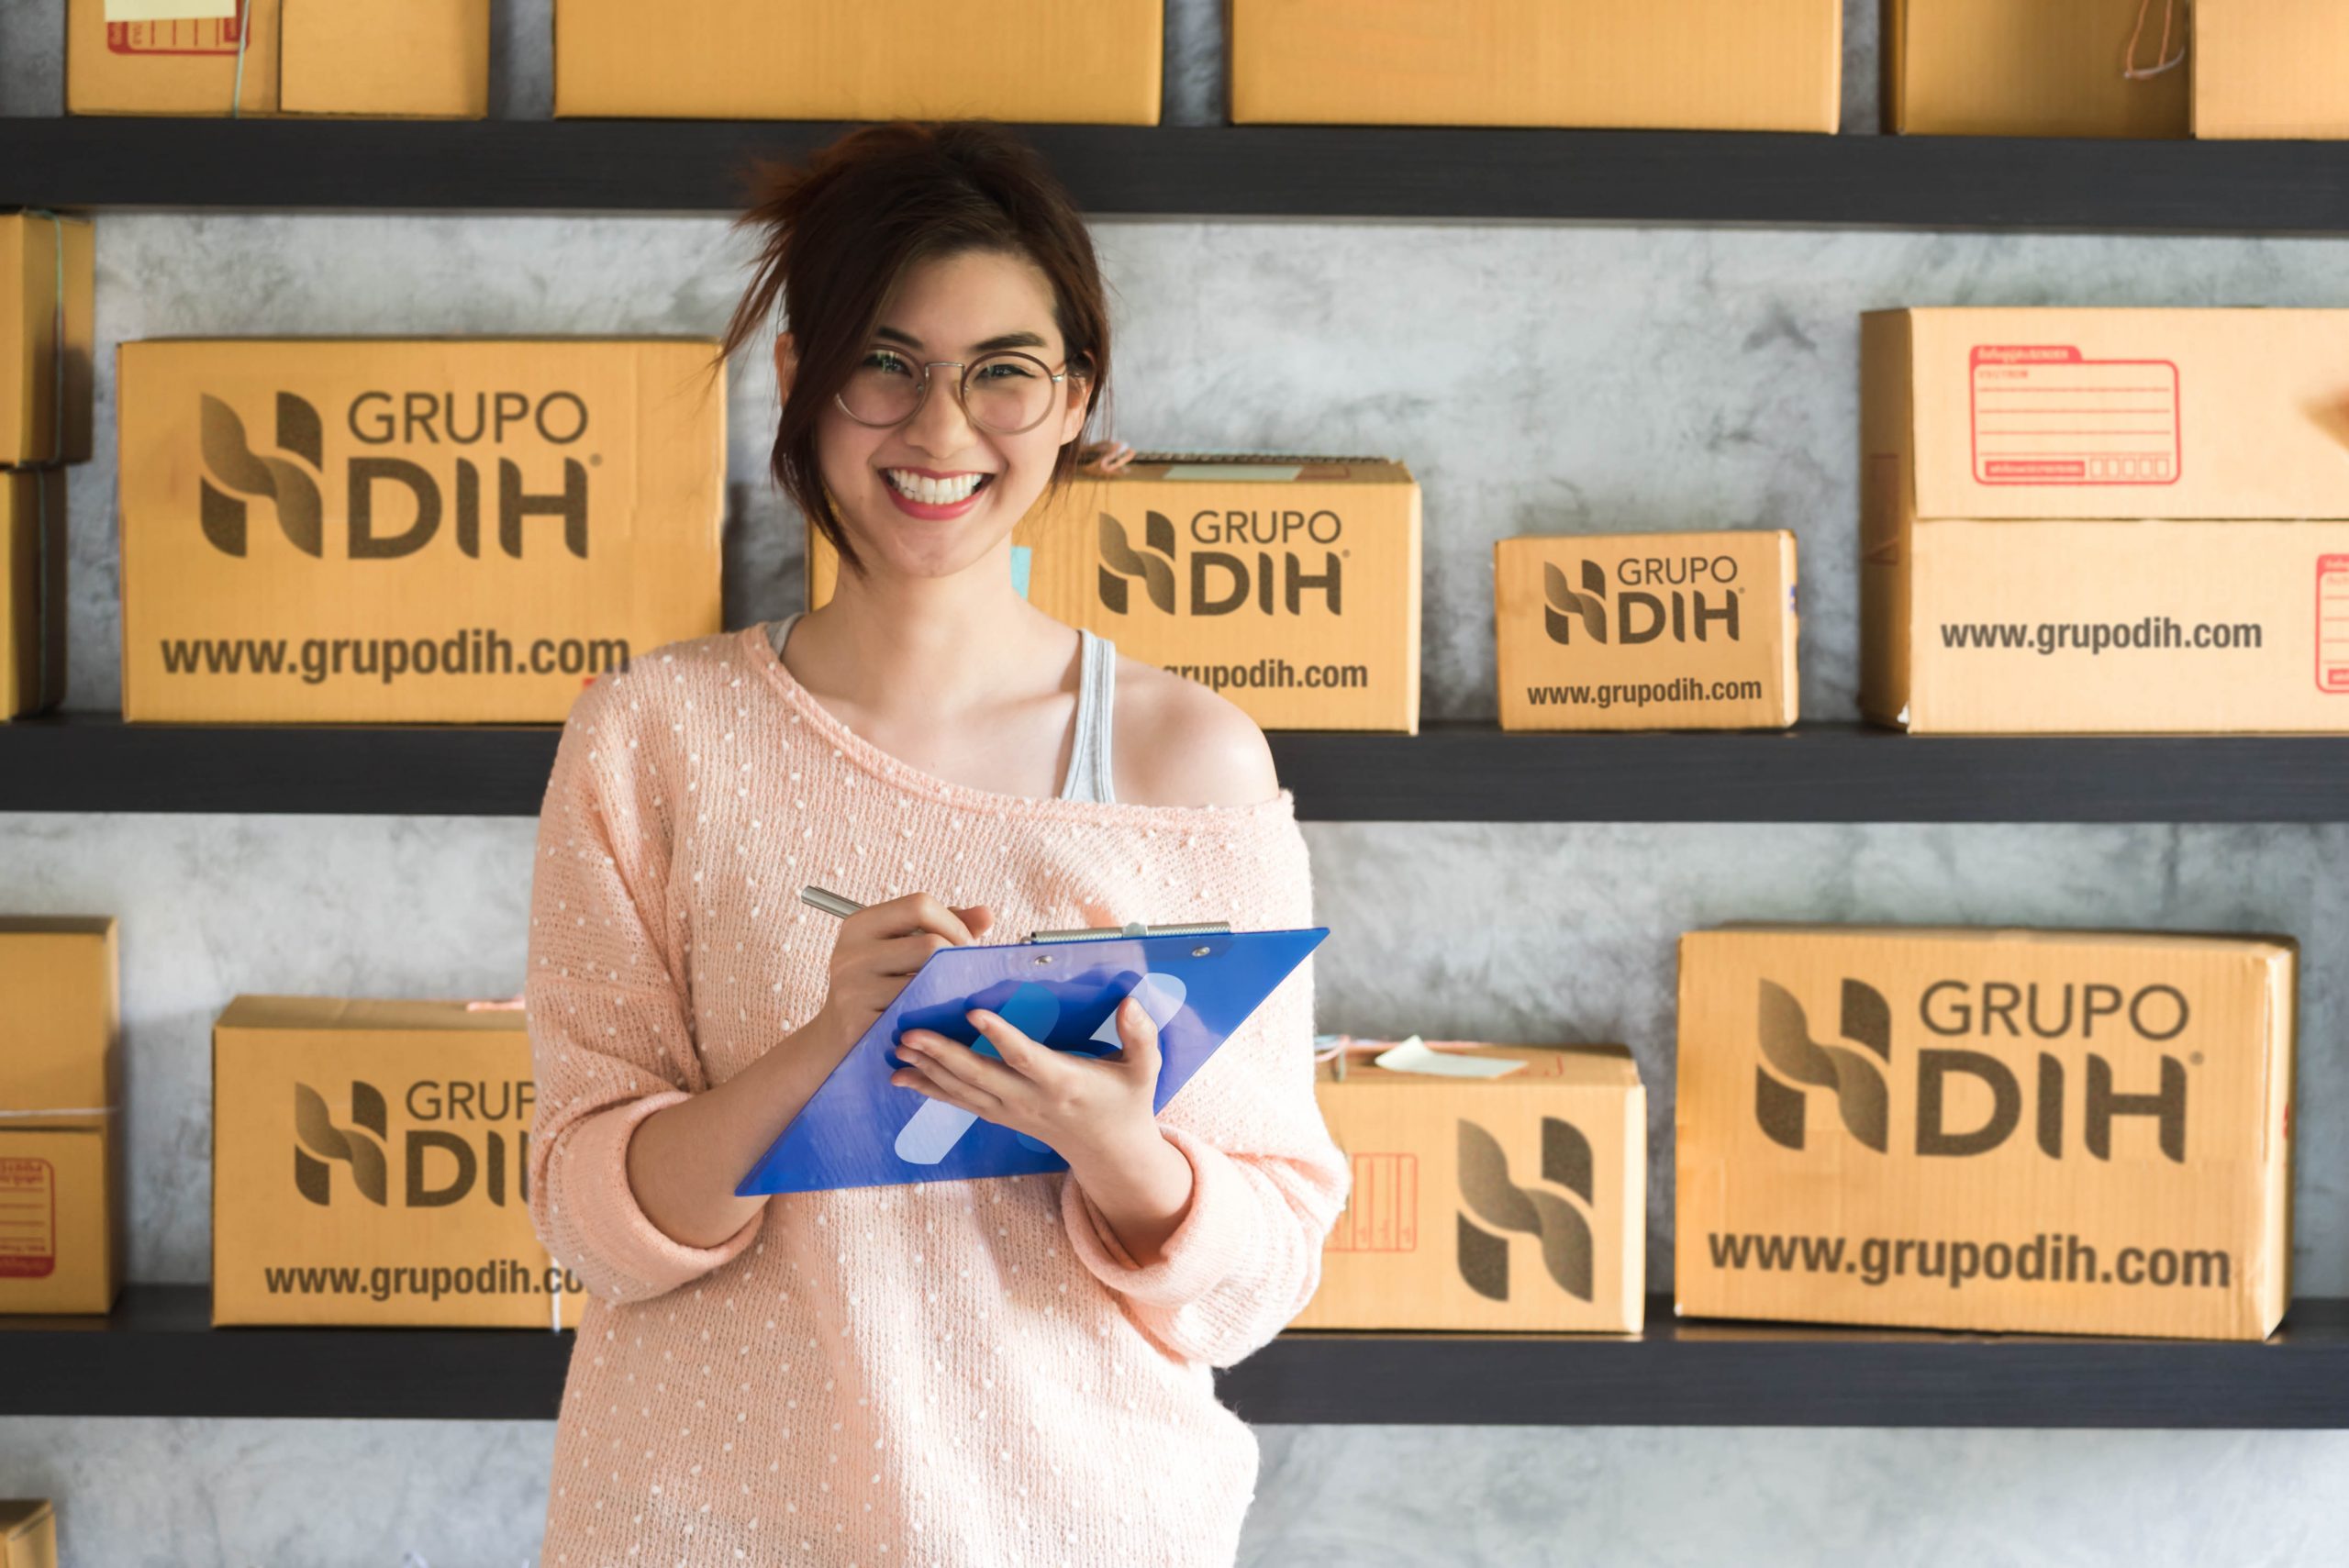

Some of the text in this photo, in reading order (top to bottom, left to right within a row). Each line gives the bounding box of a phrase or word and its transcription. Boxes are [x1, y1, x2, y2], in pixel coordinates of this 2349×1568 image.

[347, 390, 589, 446] GRUPO
[347, 456, 589, 561] DIH
[1190, 509, 1342, 545] GRUPO
[1190, 550, 1341, 617] DIH
[1617, 555, 1738, 586] GRUPO
[1618, 589, 1740, 645] DIH
[1940, 616, 2263, 656] www.grupodih.com
[159, 628, 631, 685] www.grupodih.com
[1163, 658, 1368, 694] rupodih.com
[1527, 677, 1763, 709] www.grupodih.com
[1919, 979, 2190, 1042] GRUPO
[1914, 1048, 2188, 1164] DIH
[405, 1129, 529, 1208] DI
[1708, 1232, 2231, 1289] www.grupodih.com
